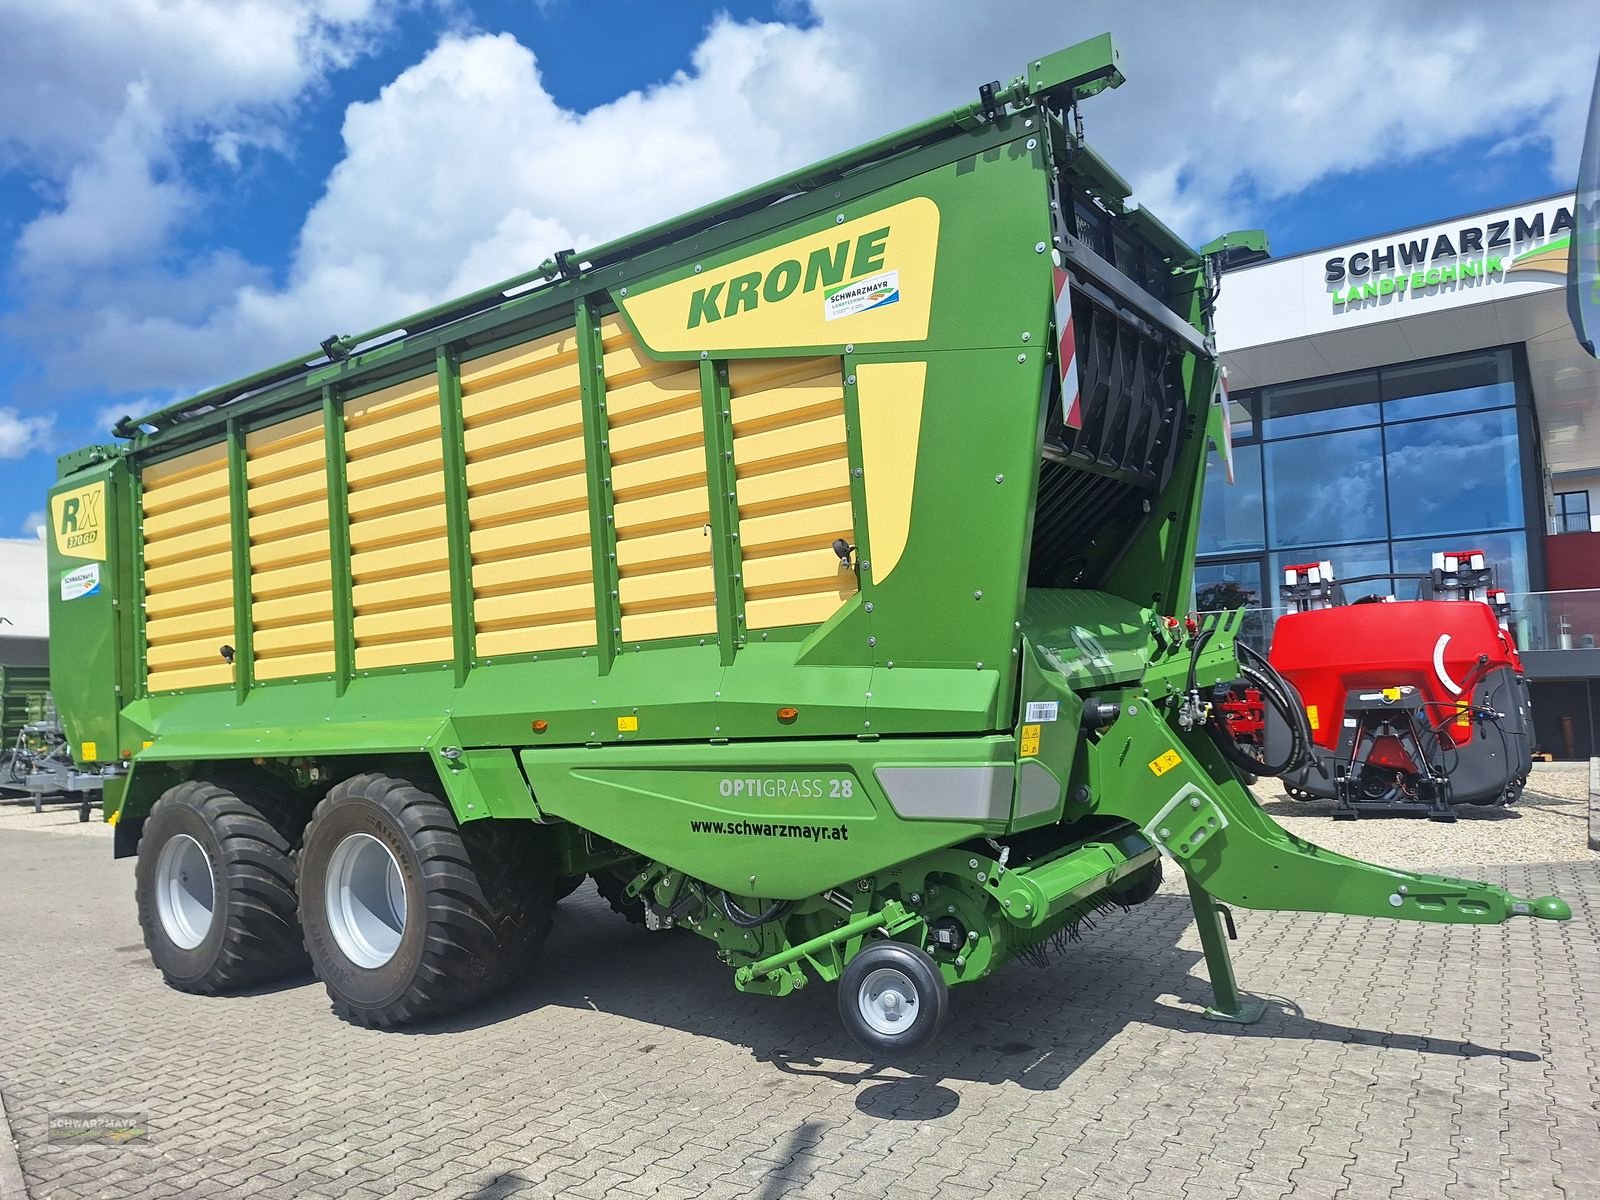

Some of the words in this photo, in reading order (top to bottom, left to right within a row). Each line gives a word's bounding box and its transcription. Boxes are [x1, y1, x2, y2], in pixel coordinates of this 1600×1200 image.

[687, 226, 891, 330] KRONE
[830, 280, 888, 303] SCHWARZMAYR
[1332, 255, 1503, 305] LANDTECHNIK
[61, 490, 101, 535] RX
[719, 779, 823, 798] OPTIGRASS
[829, 780, 853, 798] 28
[691, 820, 848, 842] www.schwarzmayr.at
